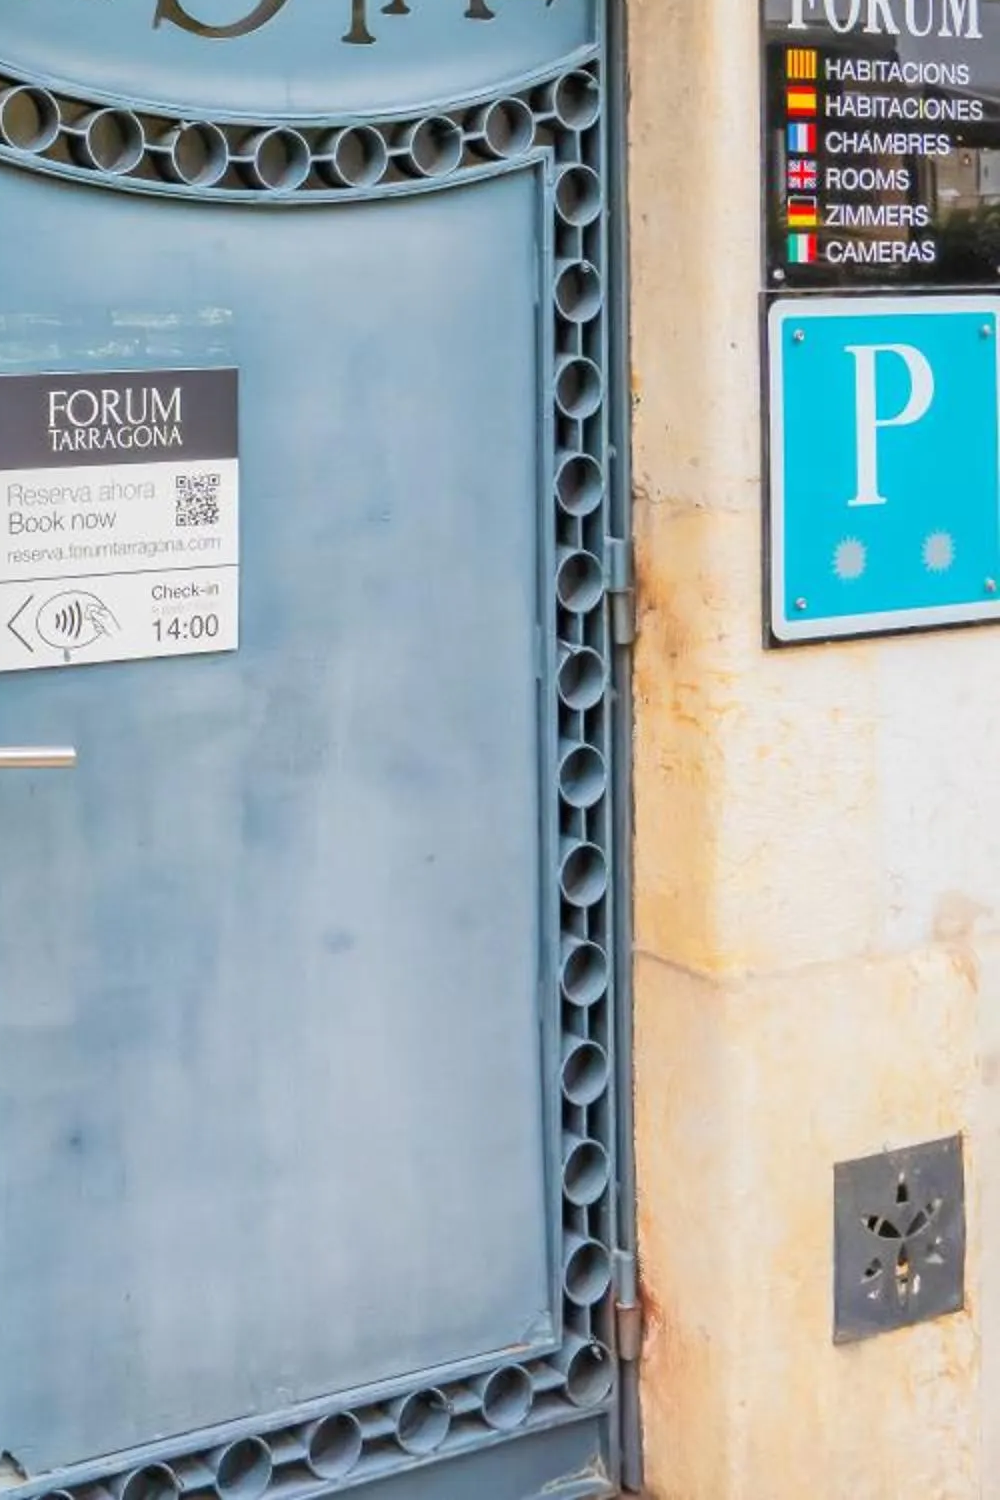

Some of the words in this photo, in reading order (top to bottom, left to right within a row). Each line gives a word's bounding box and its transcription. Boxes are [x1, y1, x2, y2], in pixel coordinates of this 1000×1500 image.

[825, 57, 970, 86] HABITACIONS
[825, 95, 984, 122] HABITACIONES
[825, 131, 951, 156] CHAMBRES
[826, 168, 911, 191] ROOMS
[825, 204, 930, 227] ZIMMERS
[825, 240, 936, 264] CAMERAS
[48, 387, 183, 428] FORUM
[48, 426, 183, 450] TARRAGONA
[843, 343, 935, 507] P
[6, 481, 93, 507] Reserva
[99, 477, 156, 503] ahora
[8, 510, 65, 535] Book
[70, 511, 118, 531] now
[7, 536, 221, 563] reserva.forumtarragona.com
[151, 581, 220, 601] Check-in
[152, 613, 219, 642] 14:00
